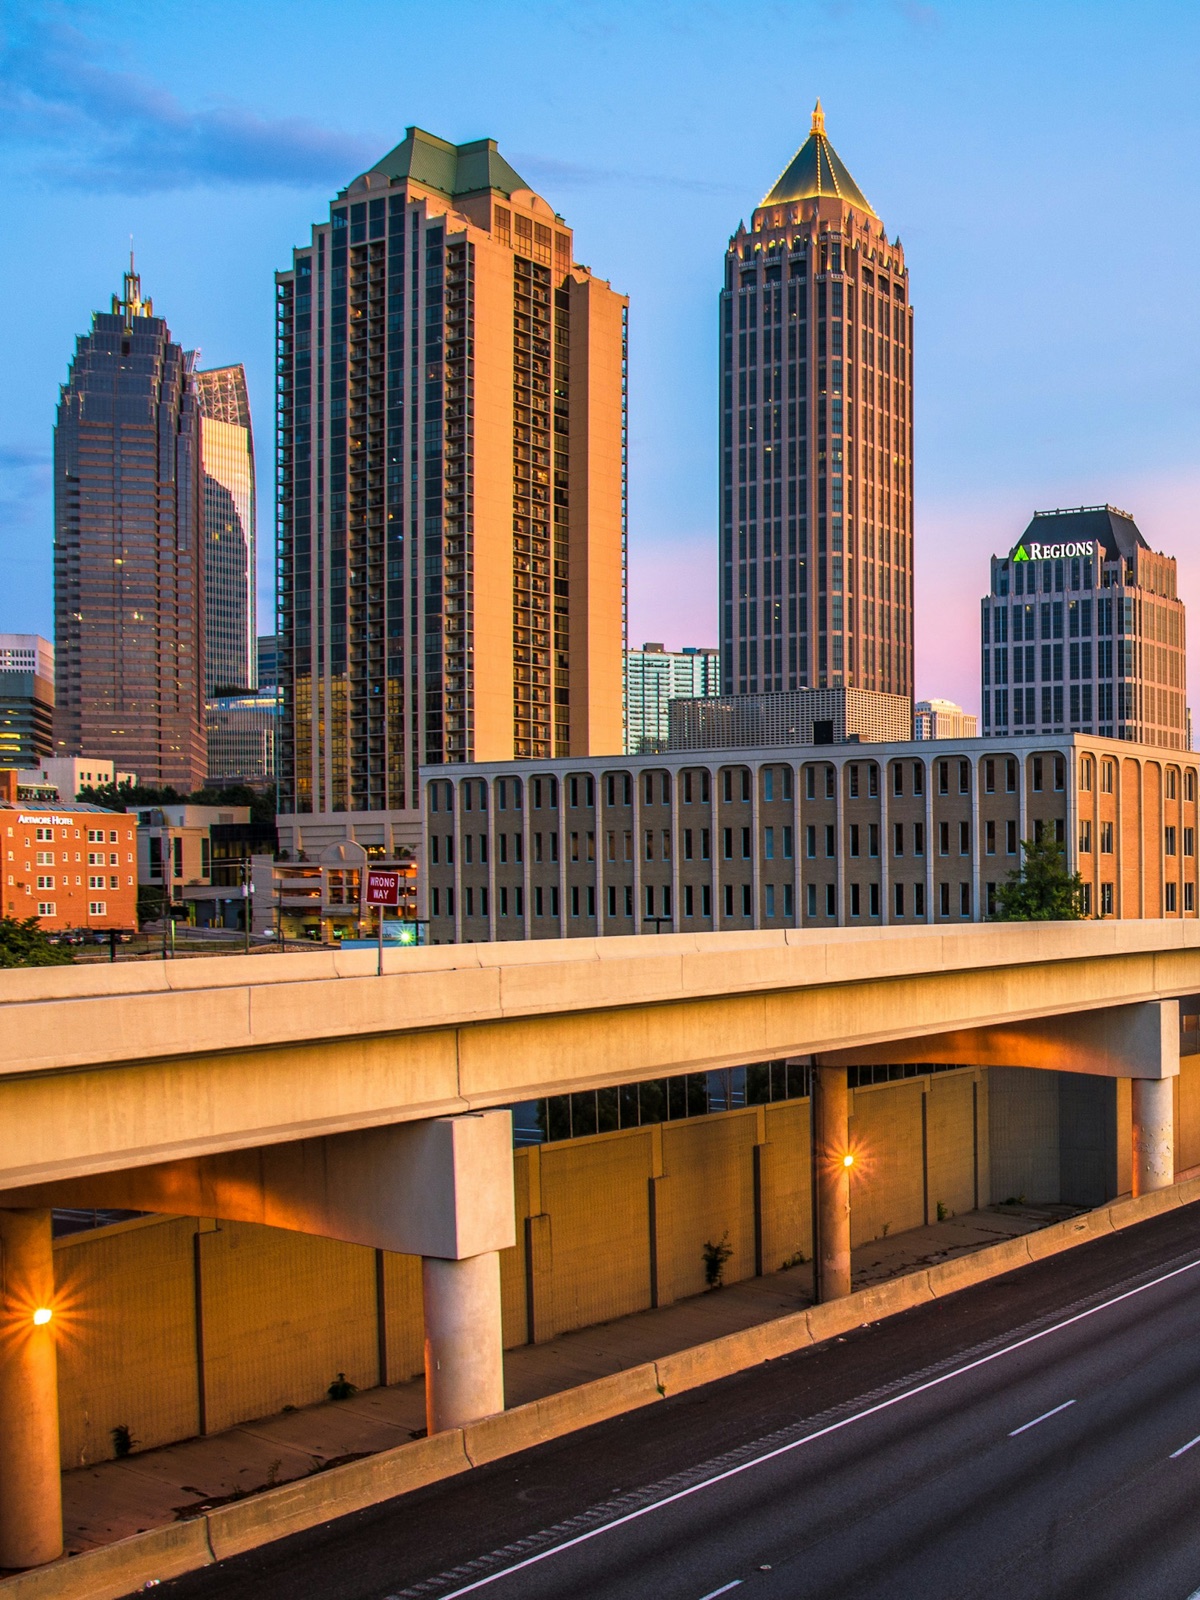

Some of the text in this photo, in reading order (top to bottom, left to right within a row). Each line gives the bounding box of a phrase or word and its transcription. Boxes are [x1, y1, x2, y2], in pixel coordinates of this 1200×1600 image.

[1030, 541, 1093, 560] REGIONS
[18, 814, 74, 826] ARTMORE HOTEL
[370, 876, 395, 888] WRONG
[373, 889, 389, 899] WAY
